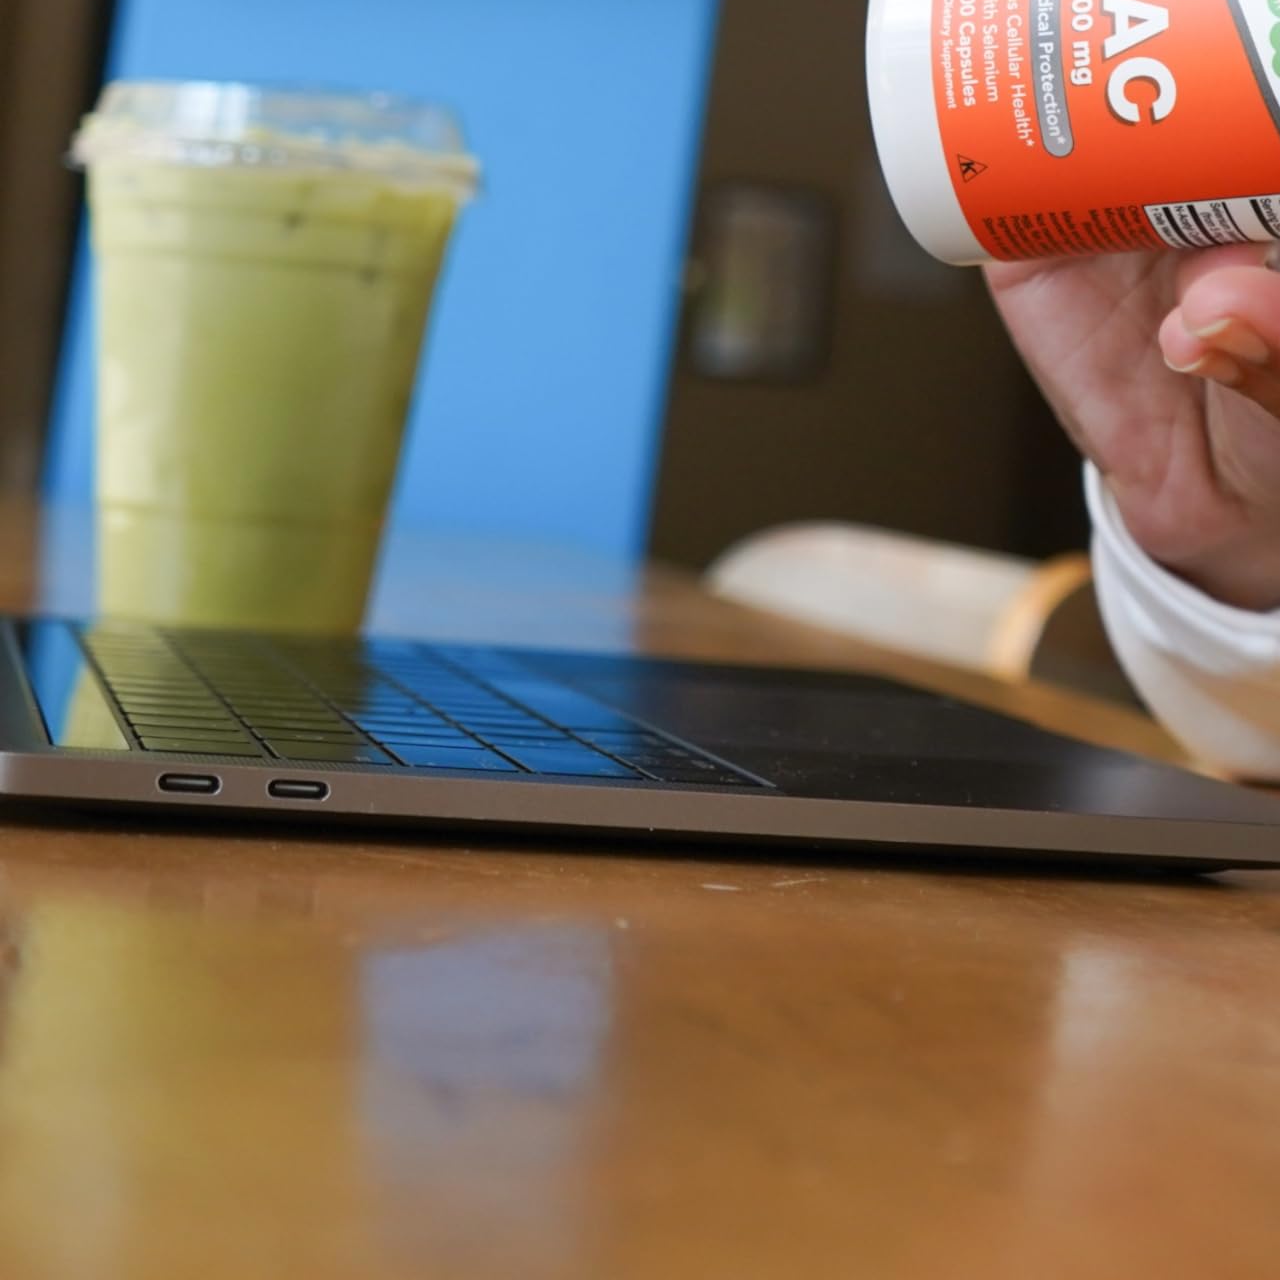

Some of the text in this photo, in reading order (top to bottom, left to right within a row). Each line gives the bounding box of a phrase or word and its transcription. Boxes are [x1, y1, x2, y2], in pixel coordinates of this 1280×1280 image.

[939, 38, 958, 109] Supplement
[955, 20, 979, 107] Capsules
[982, 23, 1000, 102] Selenium
[1006, 14, 1025, 80] Cellular
[1070, 40, 1093, 86] mg
[960, 161, 978, 176] K
